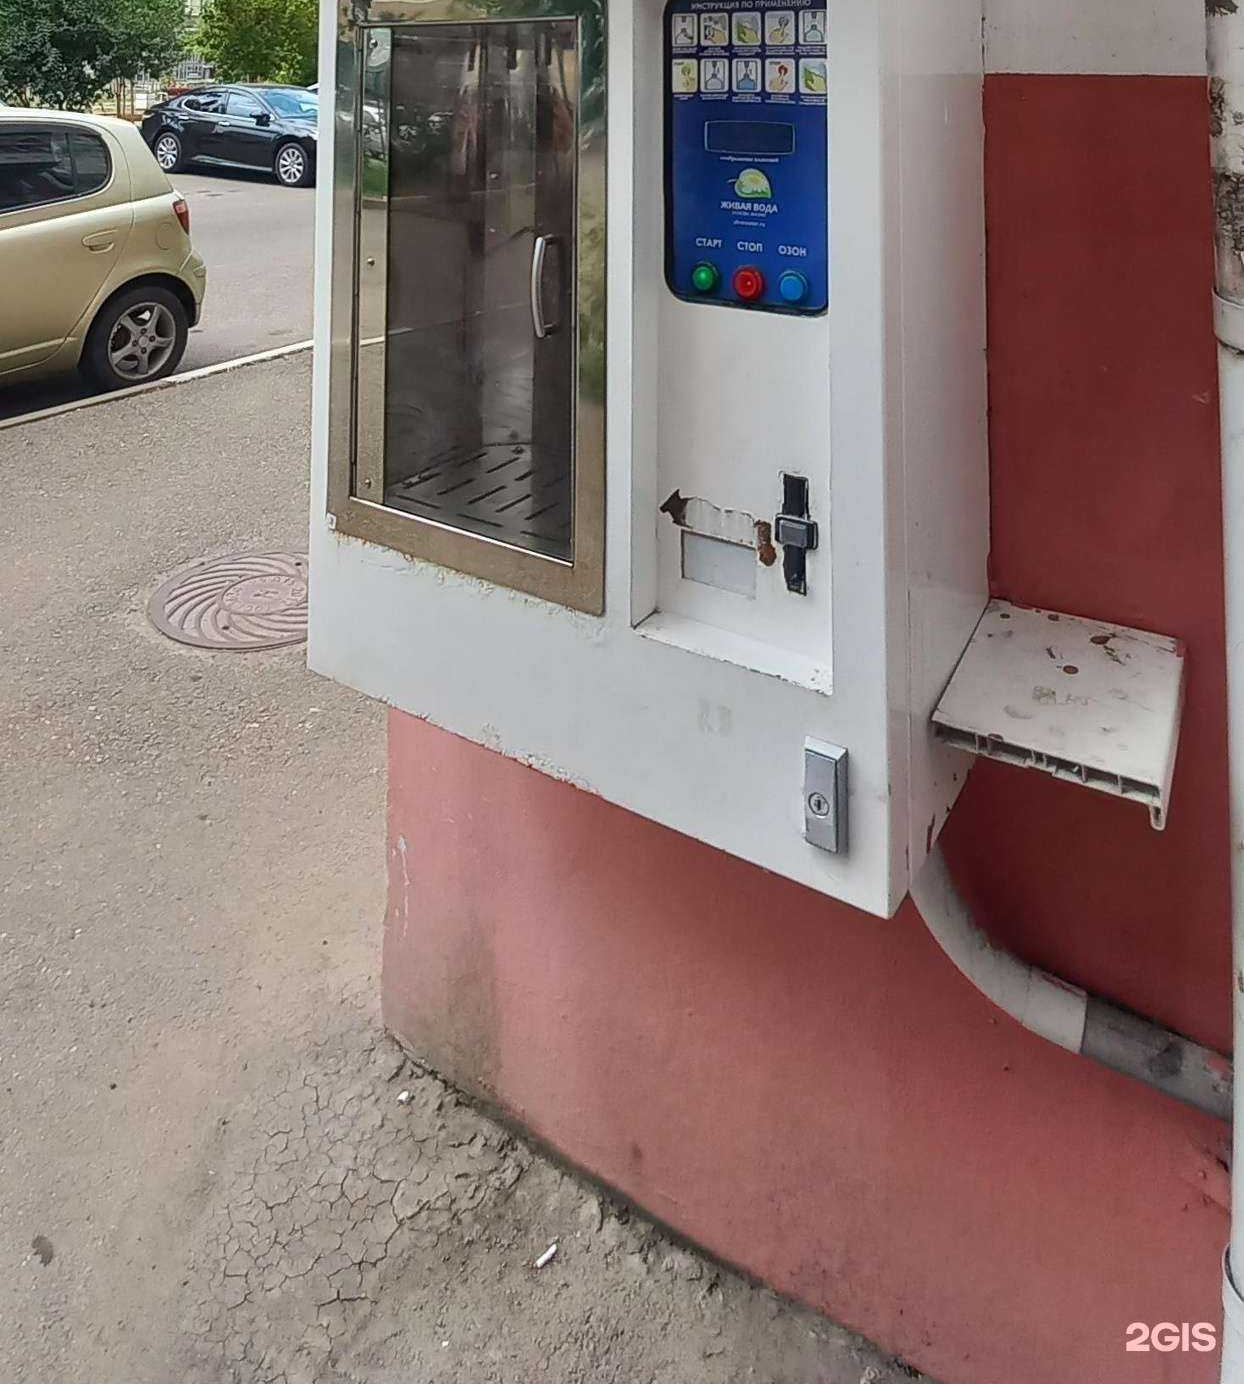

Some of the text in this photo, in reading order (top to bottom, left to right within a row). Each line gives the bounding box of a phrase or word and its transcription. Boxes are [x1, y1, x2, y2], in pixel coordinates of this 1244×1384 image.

[741, 0, 754, 9] ПО
[720, 201, 752, 211] ЖИВАЯ
[753, 203, 778, 214] ВОДА
[696, 237, 722, 248] СТАРТ
[737, 241, 763, 252] СТОП
[778, 245, 807, 256] ОЗОН
